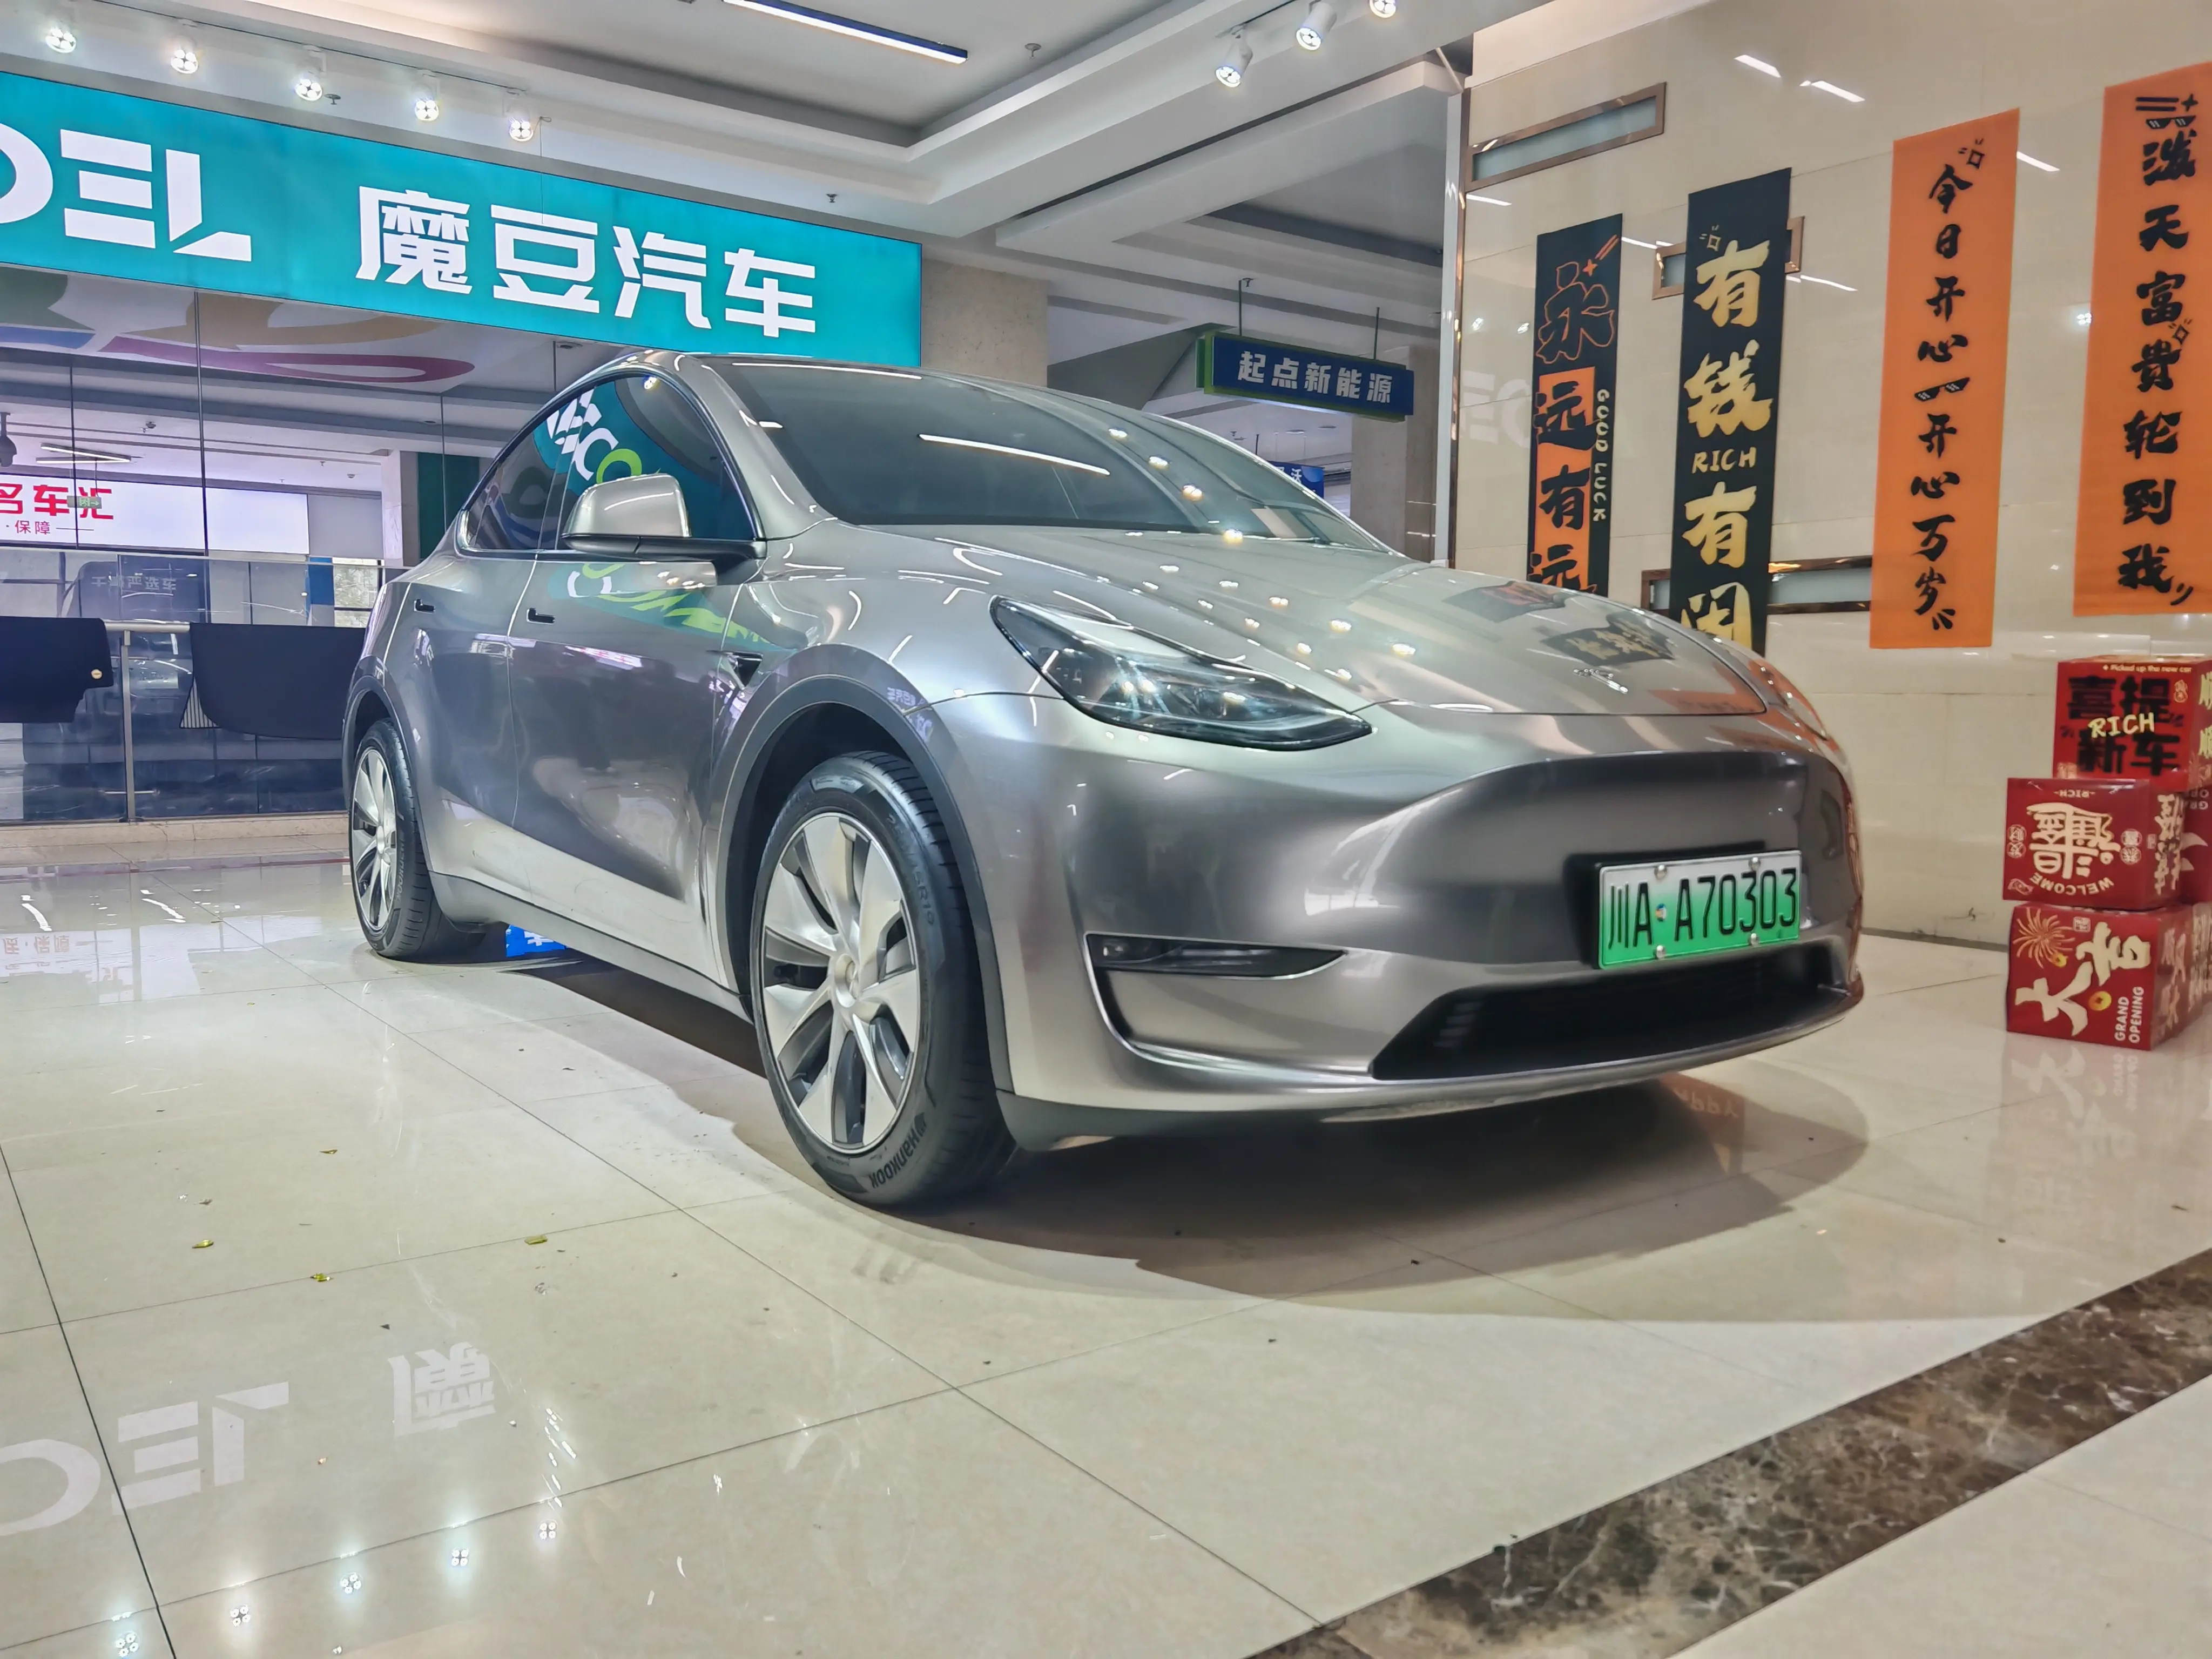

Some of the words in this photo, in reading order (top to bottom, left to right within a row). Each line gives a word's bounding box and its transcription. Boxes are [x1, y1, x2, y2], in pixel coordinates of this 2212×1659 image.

[356, 185, 815, 338] 魔豆汽车
[1238, 351, 1393, 403] 起点新能源
[1691, 447, 1757, 474] RICH
[2087, 712, 2155, 739] RICH
[2029, 872, 2115, 896] WELCOME
[2014, 921, 2151, 1036] 大吉
[2114, 996, 2130, 1041] GRAND
[2128, 986, 2144, 1043] OPENING
